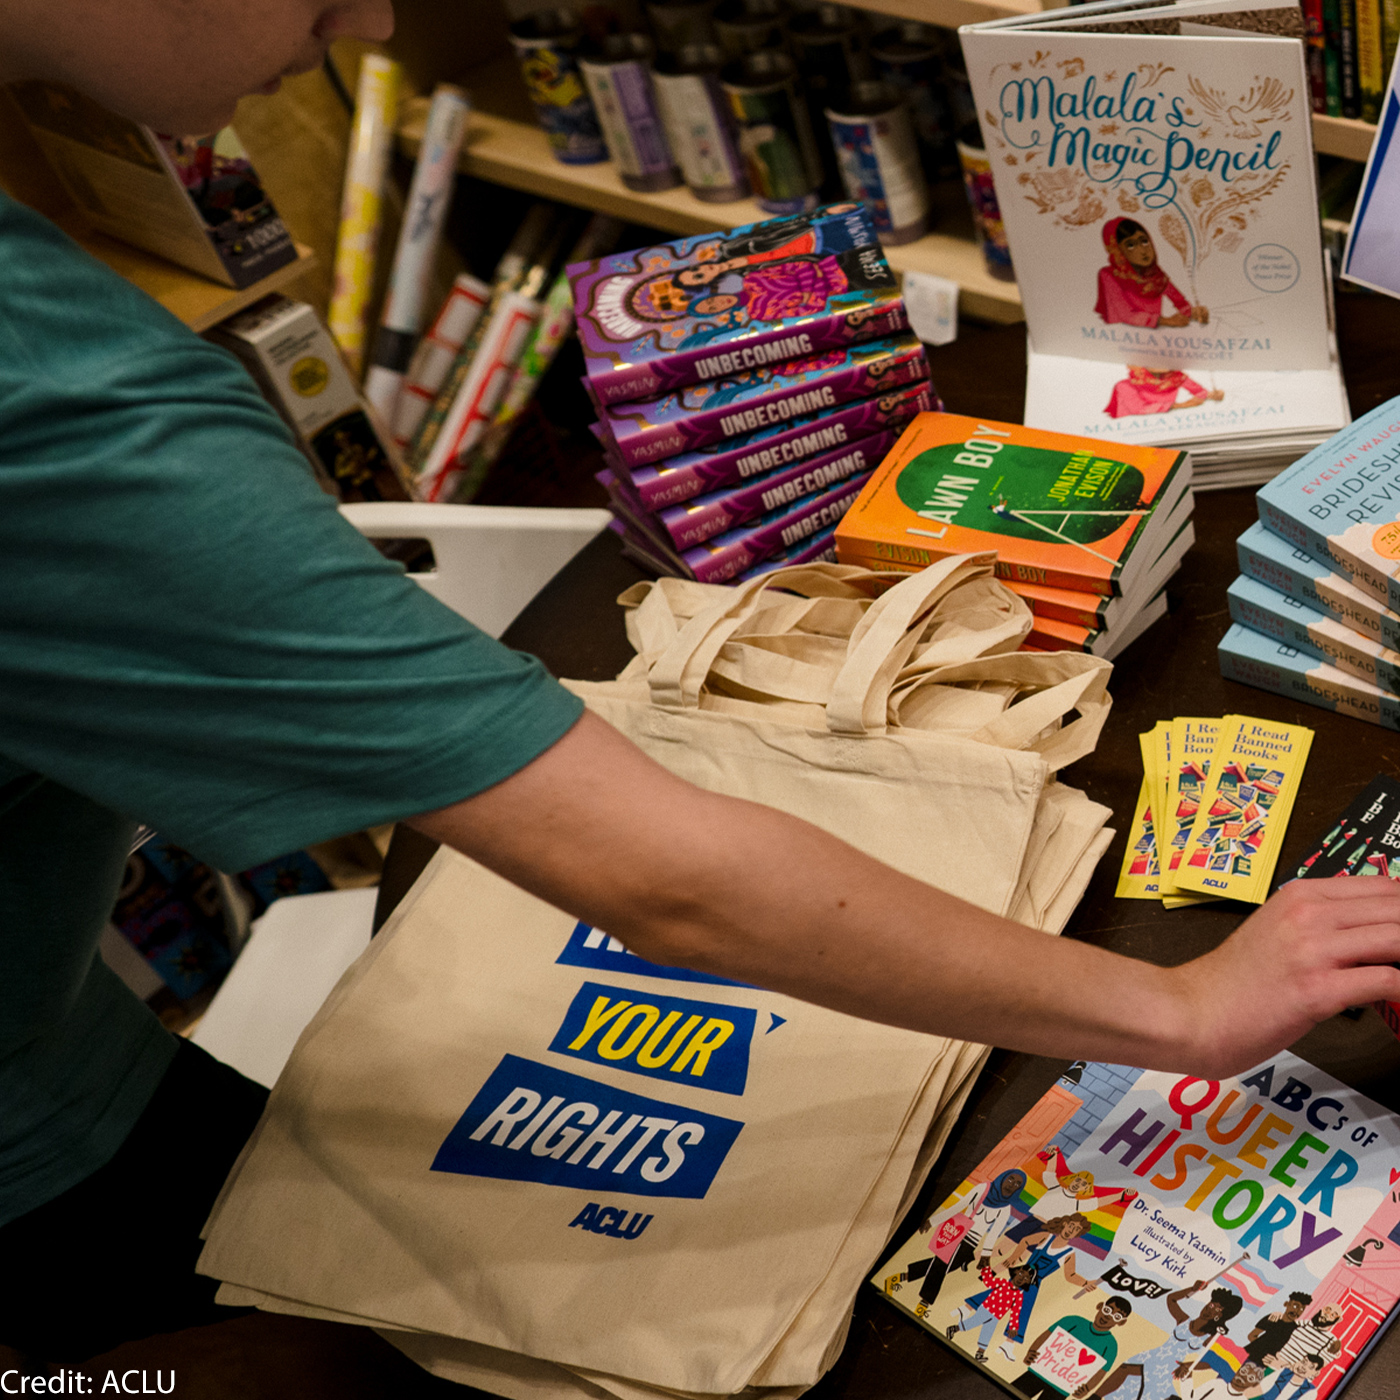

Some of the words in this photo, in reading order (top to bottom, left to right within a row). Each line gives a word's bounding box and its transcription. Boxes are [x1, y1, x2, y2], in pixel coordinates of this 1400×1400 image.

[999, 72, 1202, 148] Malala's
[1048, 122, 1158, 183] Magic
[1140, 130, 1281, 195] Pencil
[1081, 326, 1159, 346] MALALA
[1162, 335, 1271, 350] YOUSAFZAI
[694, 333, 813, 380] UNBECOMING
[604, 376, 655, 397] YASMIN
[720, 386, 836, 436] UNBECOMING
[632, 436, 682, 459] YASMIN
[736, 423, 847, 478] UNBECOMING
[761, 450, 866, 511] UNBECOMING
[906, 474, 980, 539] LAWN
[953, 424, 1012, 469] BOY
[1047, 450, 1095, 502] JONATHAN
[1074, 460, 1114, 498] EVISON
[1301, 453, 1358, 495] EVELYN
[651, 478, 699, 504] YASMIN
[681, 514, 728, 542] YASMIN
[1267, 506, 1307, 538] EVELYN
[1270, 518, 1307, 547] WAUGH
[706, 553, 748, 582] YASMIN
[876, 543, 931, 565] EVISON
[1249, 556, 1292, 583] EVELYN
[1316, 542, 1388, 594] BRIDESHEAD
[1017, 565, 1047, 583] BOY
[1251, 567, 1292, 592] WAUGH
[1239, 602, 1284, 628] EVELYN
[1243, 613, 1285, 637] WAUGH
[1302, 586, 1380, 632] BRIDESHEAD
[1294, 630, 1375, 674] BRIDESHEAD
[1291, 680, 1380, 714] BRIDESHEAD
[1184, 733, 1218, 744] Ban
[1186, 723, 1191, 733] I
[1198, 723, 1220, 733] Re
[1234, 733, 1293, 753] Banned
[1239, 723, 1246, 733] I
[1250, 726, 1290, 742] Read
[1184, 744, 1214, 754] Boo
[1231, 743, 1279, 761] Books
[1202, 878, 1229, 890] ACLU
[567, 996, 735, 1077] YOUR
[1241, 1065, 1350, 1131] ABCs
[1351, 1126, 1379, 1147] OF
[468, 1086, 706, 1183] RIGHTS
[1168, 1075, 1360, 1218] QUEER
[1098, 1107, 1343, 1270] HISTORY
[568, 1202, 654, 1239] ACLU
[943, 1222, 960, 1237] BORN
[1133, 1199, 1149, 1216] Dr.
[1150, 1209, 1187, 1240] Seema
[1187, 1232, 1227, 1266] Yasmin
[937, 1235, 950, 1246] WAY
[1130, 1234, 1161, 1262] Lucy
[1161, 1255, 1188, 1279] Kirk
[1143, 1225, 1184, 1256] illustrated
[1184, 1251, 1195, 1264] by
[1111, 1272, 1162, 1298] LOVE!
[1050, 1331, 1077, 1358] We
